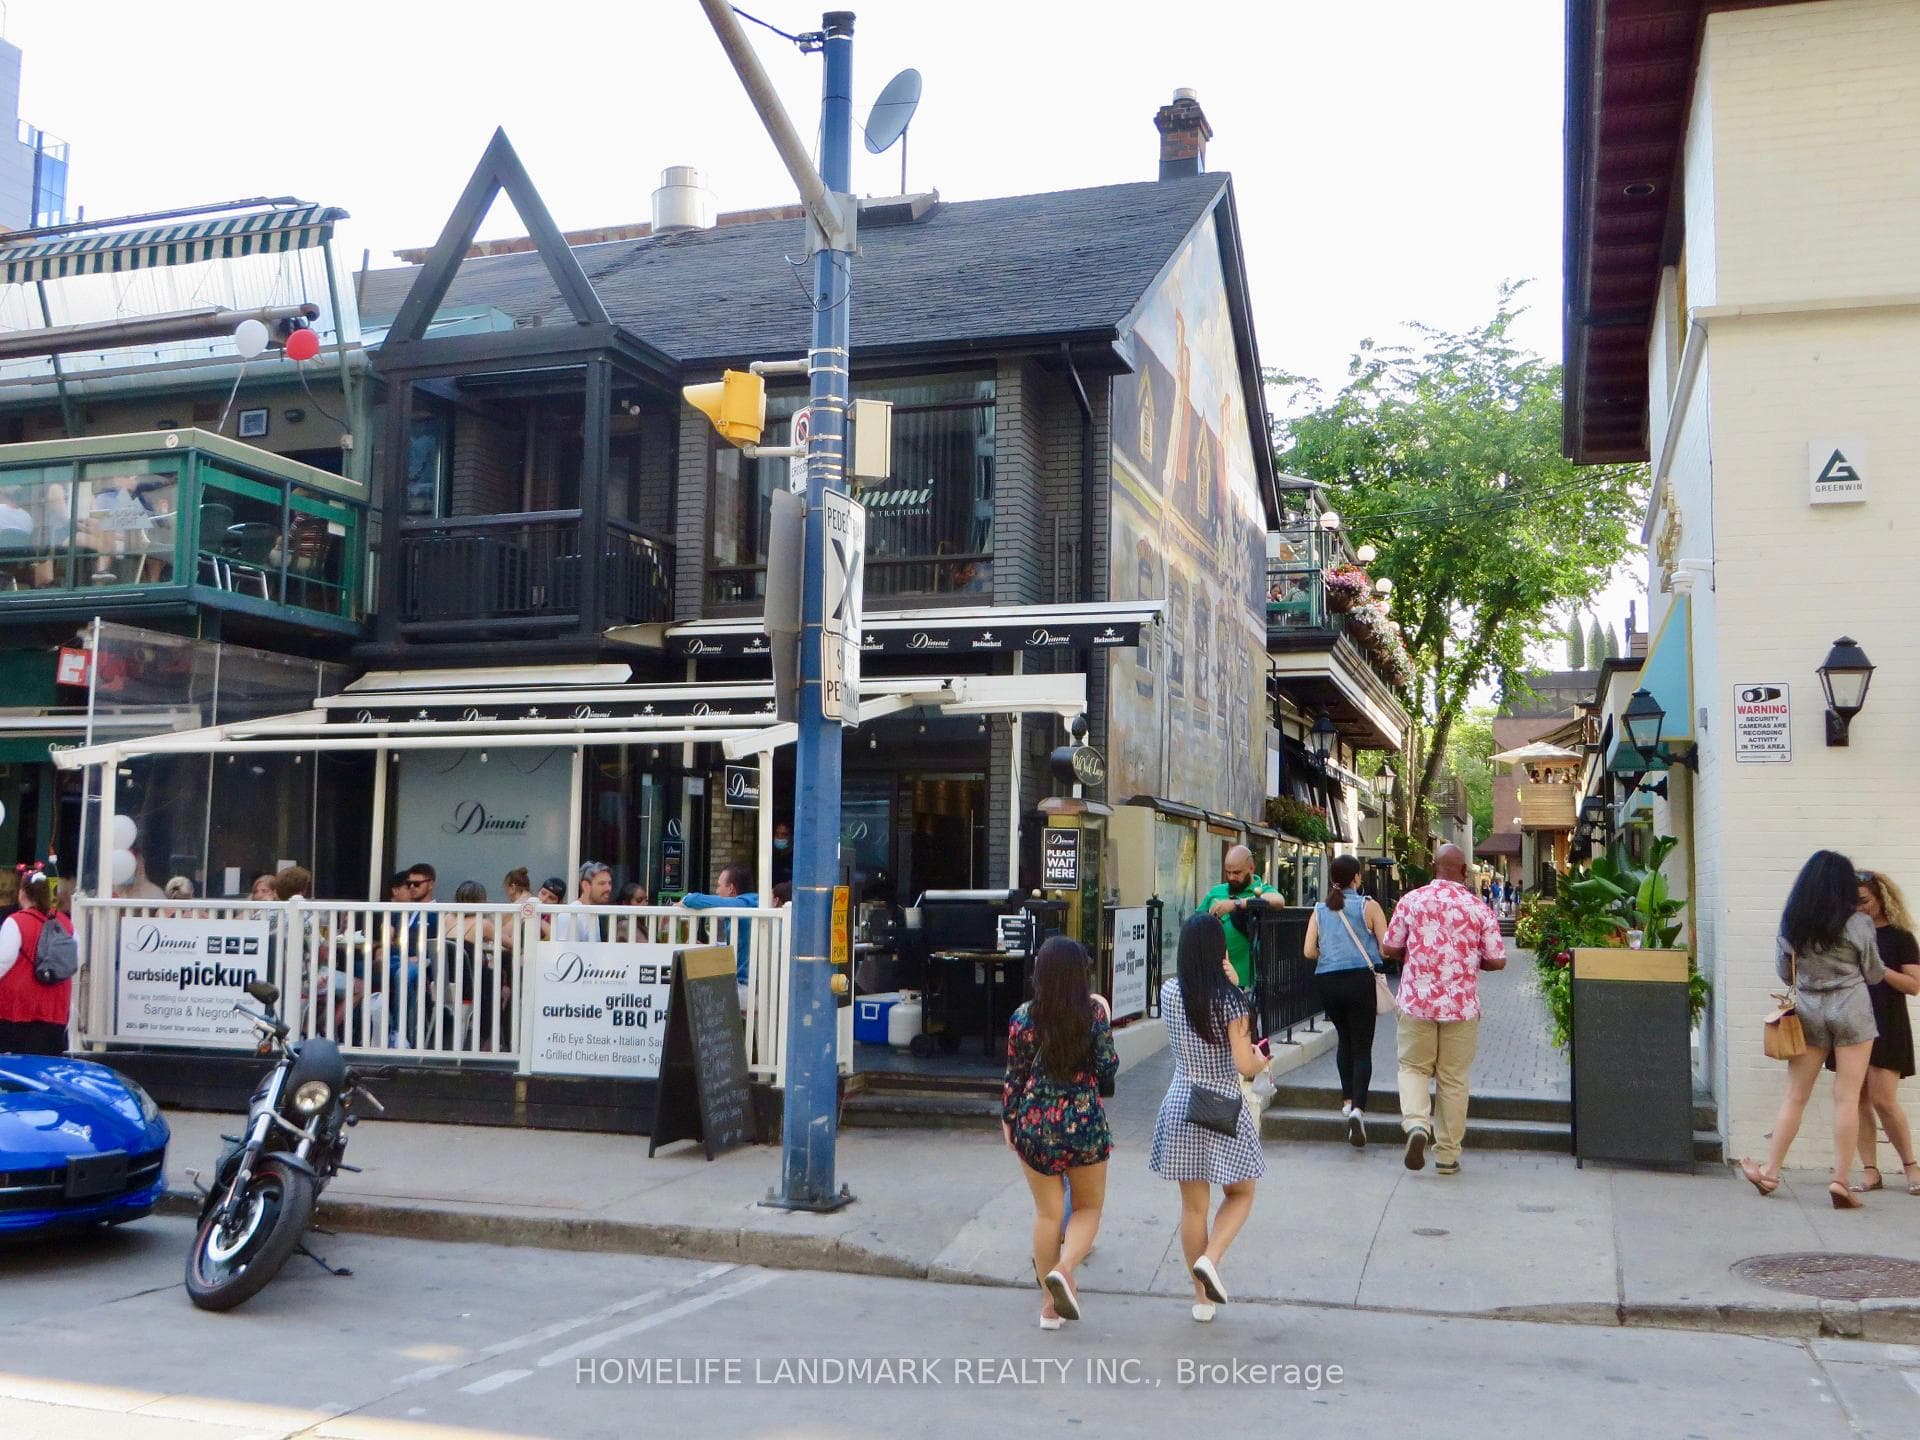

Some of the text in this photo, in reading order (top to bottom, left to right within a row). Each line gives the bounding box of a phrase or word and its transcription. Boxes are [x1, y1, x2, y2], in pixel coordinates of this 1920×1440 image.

[1815, 483, 1863, 492] GREENWIN
[879, 508, 931, 518] TRATTORIA
[684, 638, 723, 655] Dimmi
[906, 632, 950, 649] Dimmi
[972, 639, 1002, 648] Heineken
[1025, 628, 1071, 646] Dimmi
[1094, 635, 1124, 643] Heineken
[1737, 705, 1787, 714] WARNING
[441, 800, 529, 834] Dimmi
[1047, 859, 1075, 867] WAIT
[1047, 869, 1075, 878] HERE
[127, 924, 200, 953] Dimmi
[544, 952, 629, 983] Dimmi
[127, 961, 257, 992] curbside pickup
[606, 993, 652, 1010] grilled
[186, 1006, 192, 1016] &
[543, 1004, 602, 1018] curbside
[613, 1010, 648, 1028] BBQ
[552, 1033, 566, 1043] Rib
[569, 1034, 583, 1046] Eye
[587, 1034, 610, 1045] Steak
[620, 1036, 645, 1047] Italian
[546, 1049, 573, 1060] Grilled
[576, 1051, 610, 1062] Chicken
[613, 1052, 641, 1063] Breast
